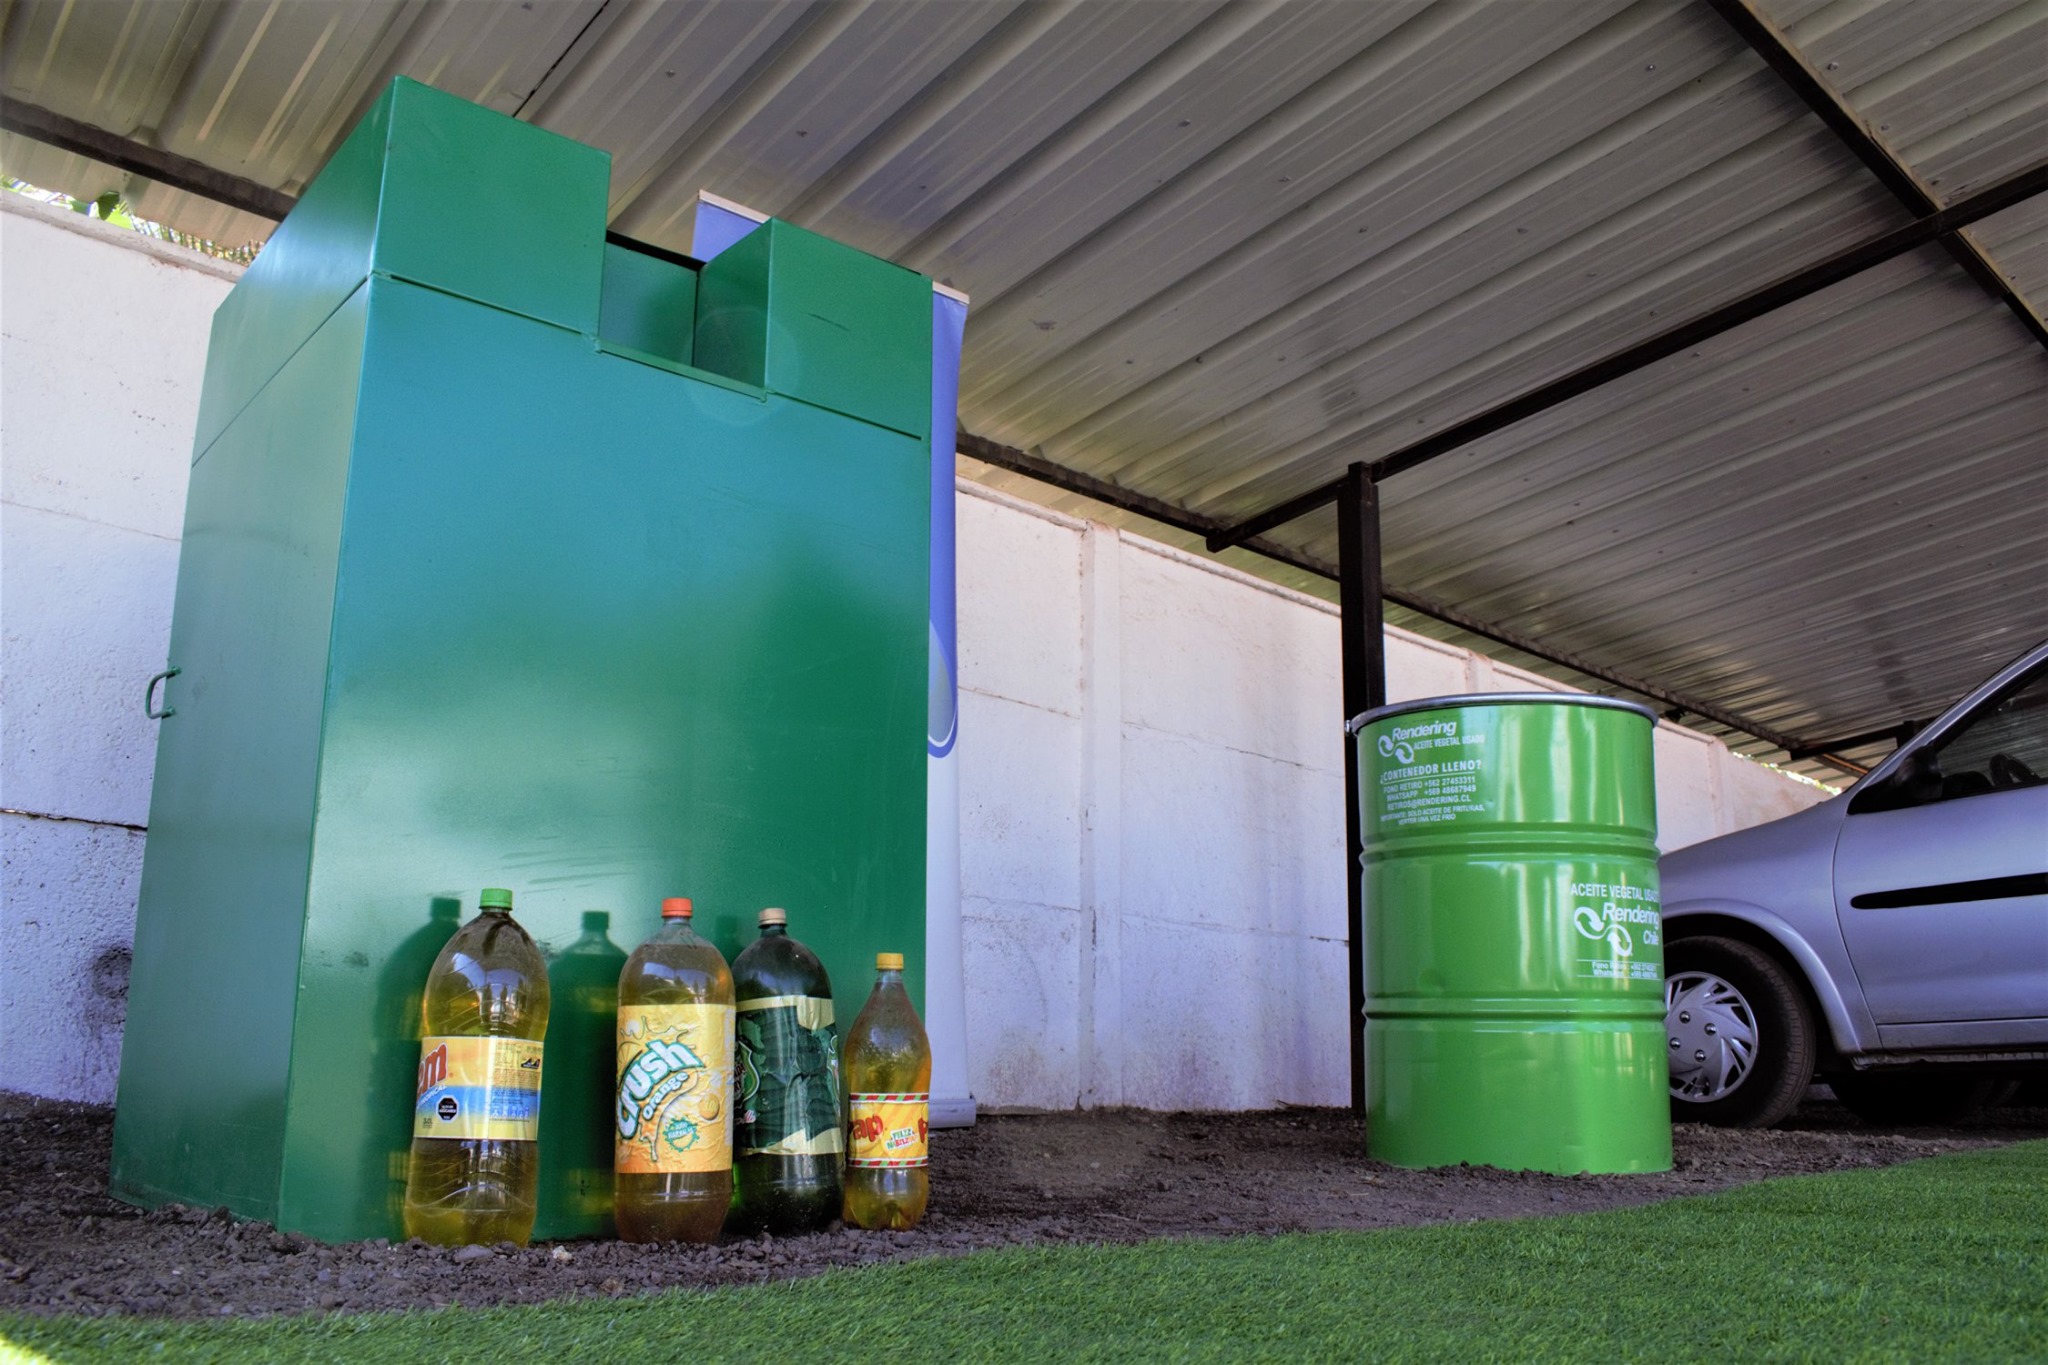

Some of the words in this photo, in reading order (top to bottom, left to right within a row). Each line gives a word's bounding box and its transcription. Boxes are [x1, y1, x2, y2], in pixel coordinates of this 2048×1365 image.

[1392, 721, 1457, 741] Rendering
[1414, 740, 1433, 750] ACEITE
[1434, 738, 1460, 748] VEGETAL
[1442, 760, 1482, 772] LLENO?
[1400, 780, 1422, 792] RETIRO
[1387, 790, 1418, 801] WHATSAPP
[1570, 883, 1607, 897] ACEITE
[1609, 884, 1643, 900] VEGETAL
[1603, 902, 1659, 930] Rendering
[1643, 930, 1659, 945] Chile
[642, 1071, 690, 1120] orange
